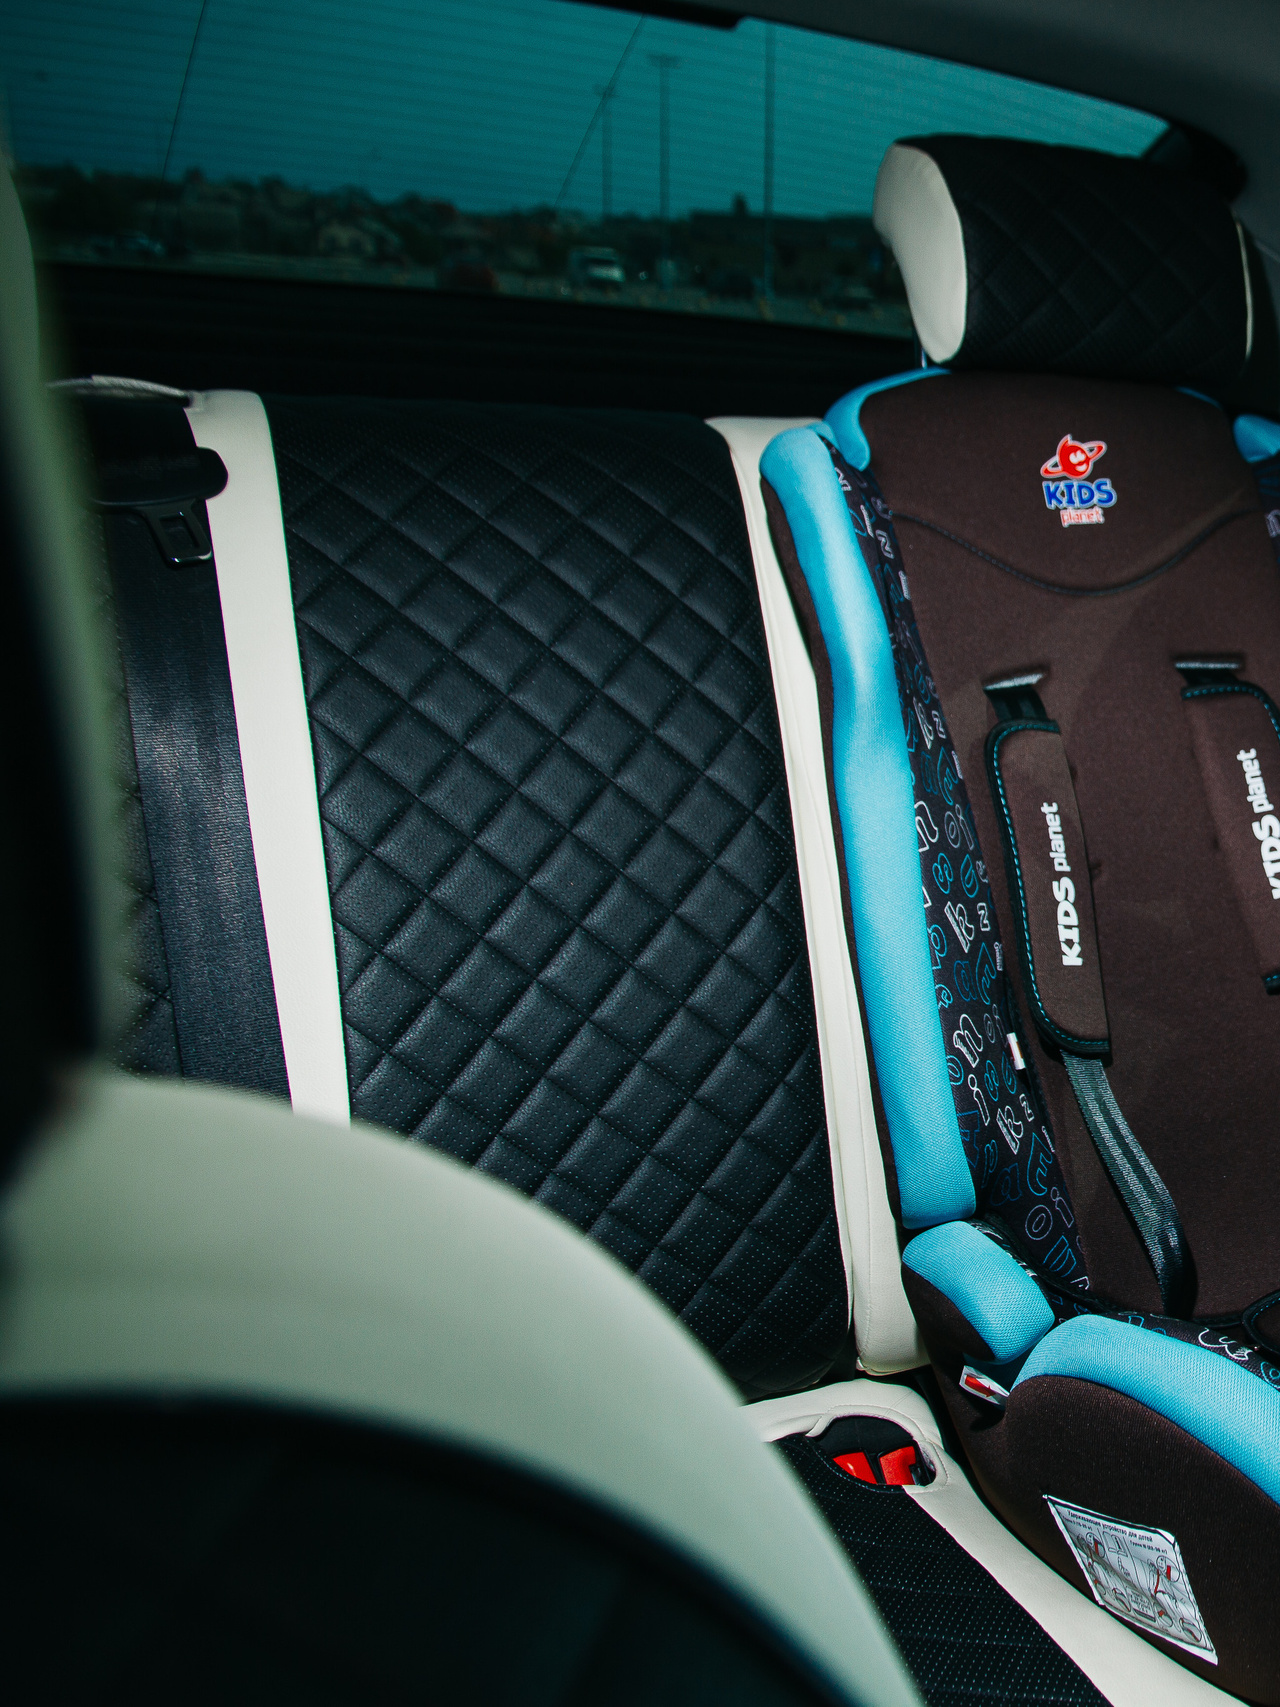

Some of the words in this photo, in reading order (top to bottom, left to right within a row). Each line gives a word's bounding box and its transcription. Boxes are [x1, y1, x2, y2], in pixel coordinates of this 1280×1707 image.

[1042, 478, 1117, 510] KIDS
[1060, 506, 1105, 528] planet
[1236, 748, 1274, 813] planet
[1040, 802, 1071, 872] planet
[1052, 876, 1083, 966] KIDS
